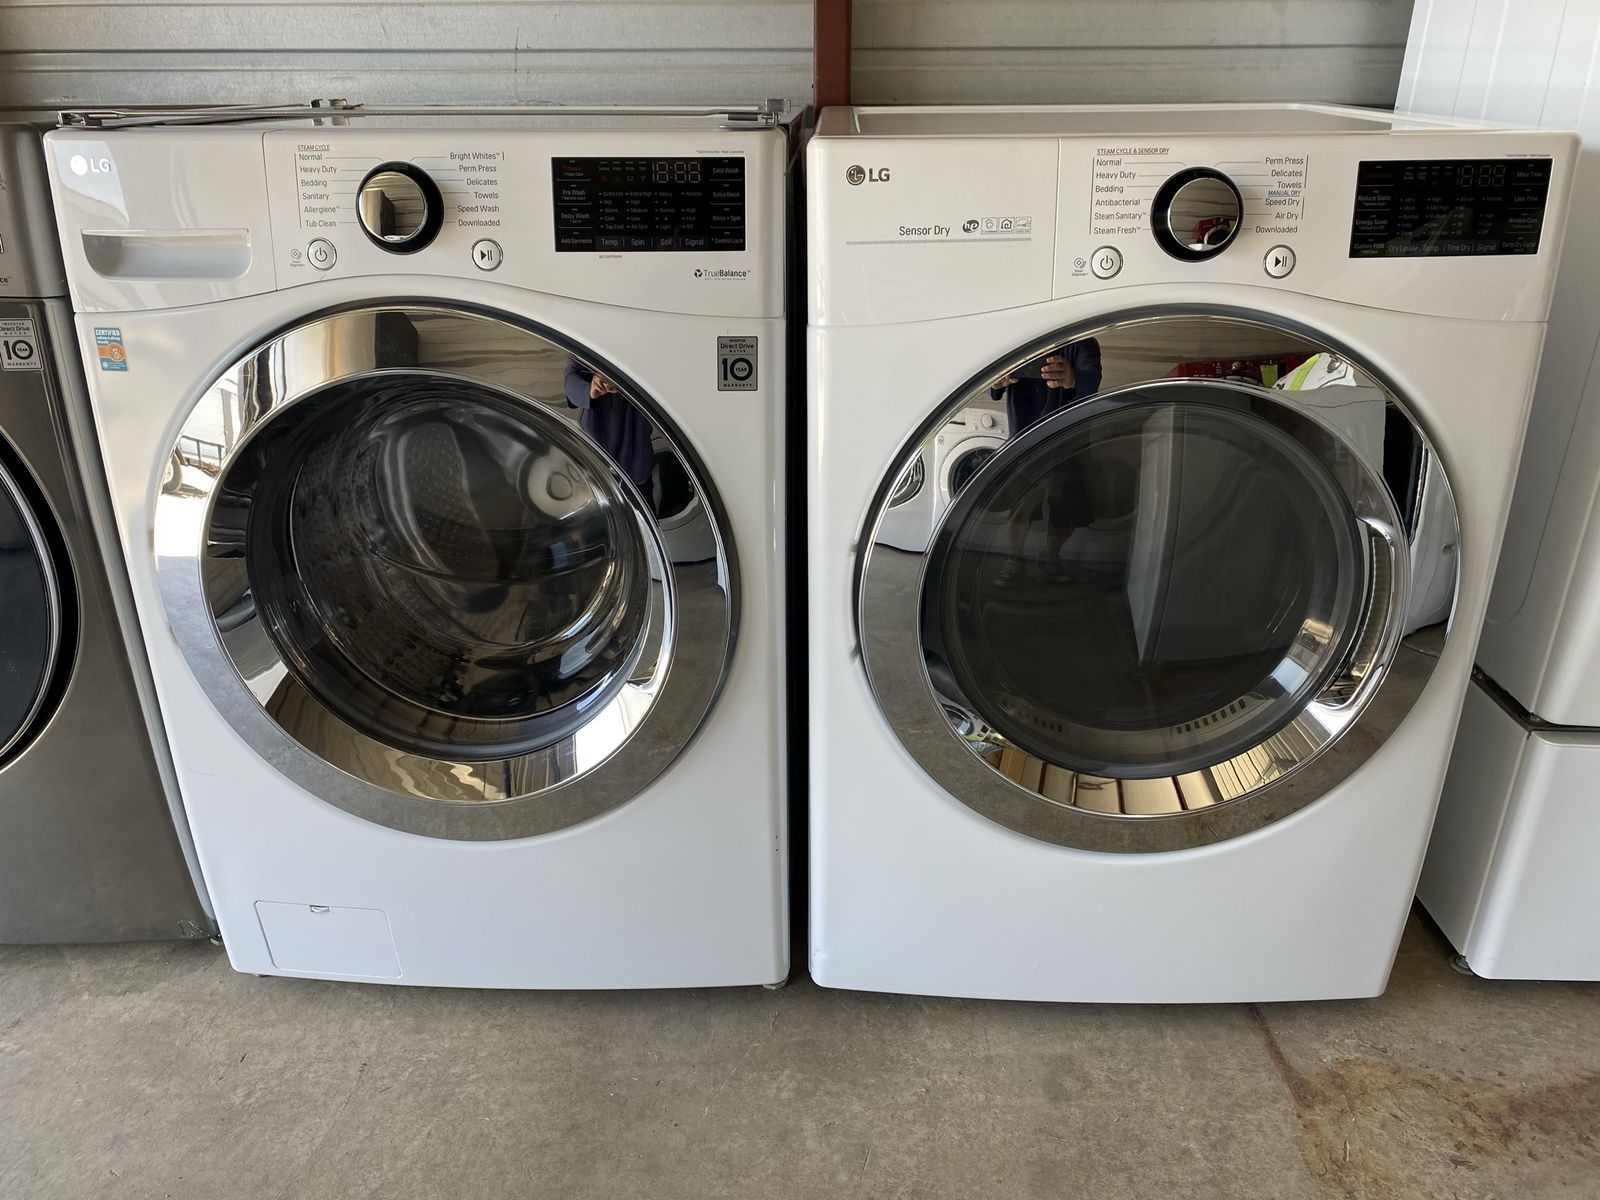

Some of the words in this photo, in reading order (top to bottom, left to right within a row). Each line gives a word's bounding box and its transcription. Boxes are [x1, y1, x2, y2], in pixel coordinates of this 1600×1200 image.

[450, 152, 471, 160] Bright
[1266, 156, 1284, 164] Perm
[1285, 156, 1304, 164] Press
[90, 158, 111, 173] LG
[322, 165, 337, 174] Duty
[869, 167, 890, 182] LG
[1096, 171, 1118, 179] Heavy
[1120, 170, 1136, 179] Duty
[1272, 169, 1302, 177] Delicates
[301, 180, 328, 188] Bedding
[466, 178, 498, 186] Delicates
[1278, 181, 1302, 189] Towels
[1095, 185, 1124, 194] Bedding
[302, 192, 330, 200] Sanitary
[474, 192, 498, 200] Towels
[1095, 198, 1140, 206] Antibacterial
[1265, 198, 1286, 206] Speed
[1288, 198, 1300, 206] Dry
[457, 204, 478, 213] Speed
[480, 204, 500, 212] Wash
[1094, 212, 1114, 220] Steam
[1286, 212, 1298, 220] Dry
[305, 220, 318, 228] Tub
[318, 220, 337, 228] Clean
[458, 219, 500, 227] Downloaded
[900, 226, 932, 236] Sensor
[934, 225, 951, 237] Dry
[1094, 226, 1116, 234] Steam
[1256, 225, 1298, 234] Downloaded
[630, 238, 646, 247] Spin
[660, 238, 673, 246] Soil
[684, 238, 704, 248] Signal
[4, 340, 34, 360] 10
[722, 358, 753, 381] 10
